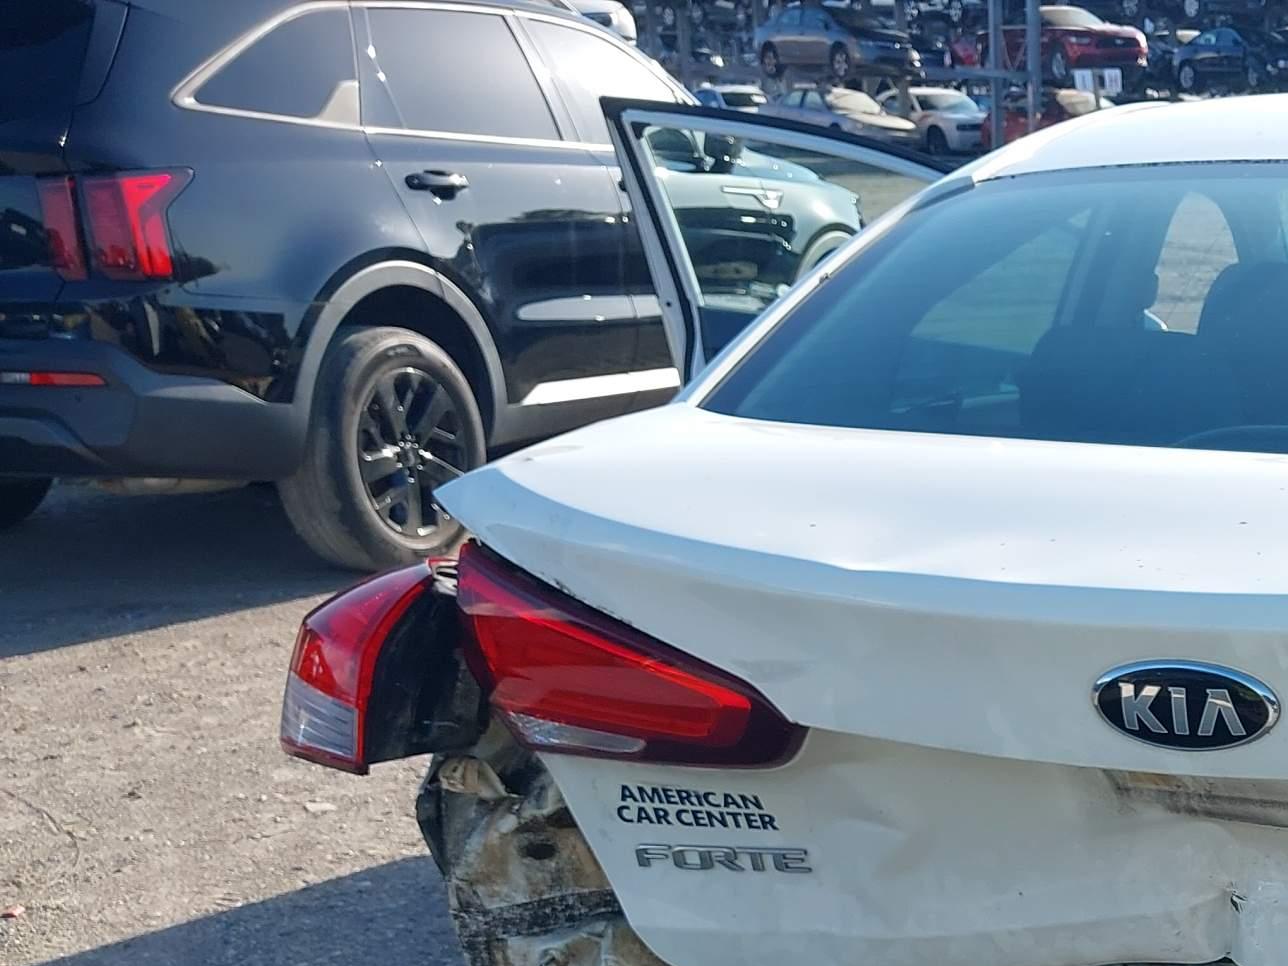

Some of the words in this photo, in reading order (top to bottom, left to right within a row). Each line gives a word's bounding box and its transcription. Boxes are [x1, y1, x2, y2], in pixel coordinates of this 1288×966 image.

[1117, 681, 1248, 737] KIA
[619, 784, 765, 812] AMERICAN
[616, 804, 674, 826] CAR
[675, 808, 780, 831] CENTER
[634, 842, 814, 874] FORTE
